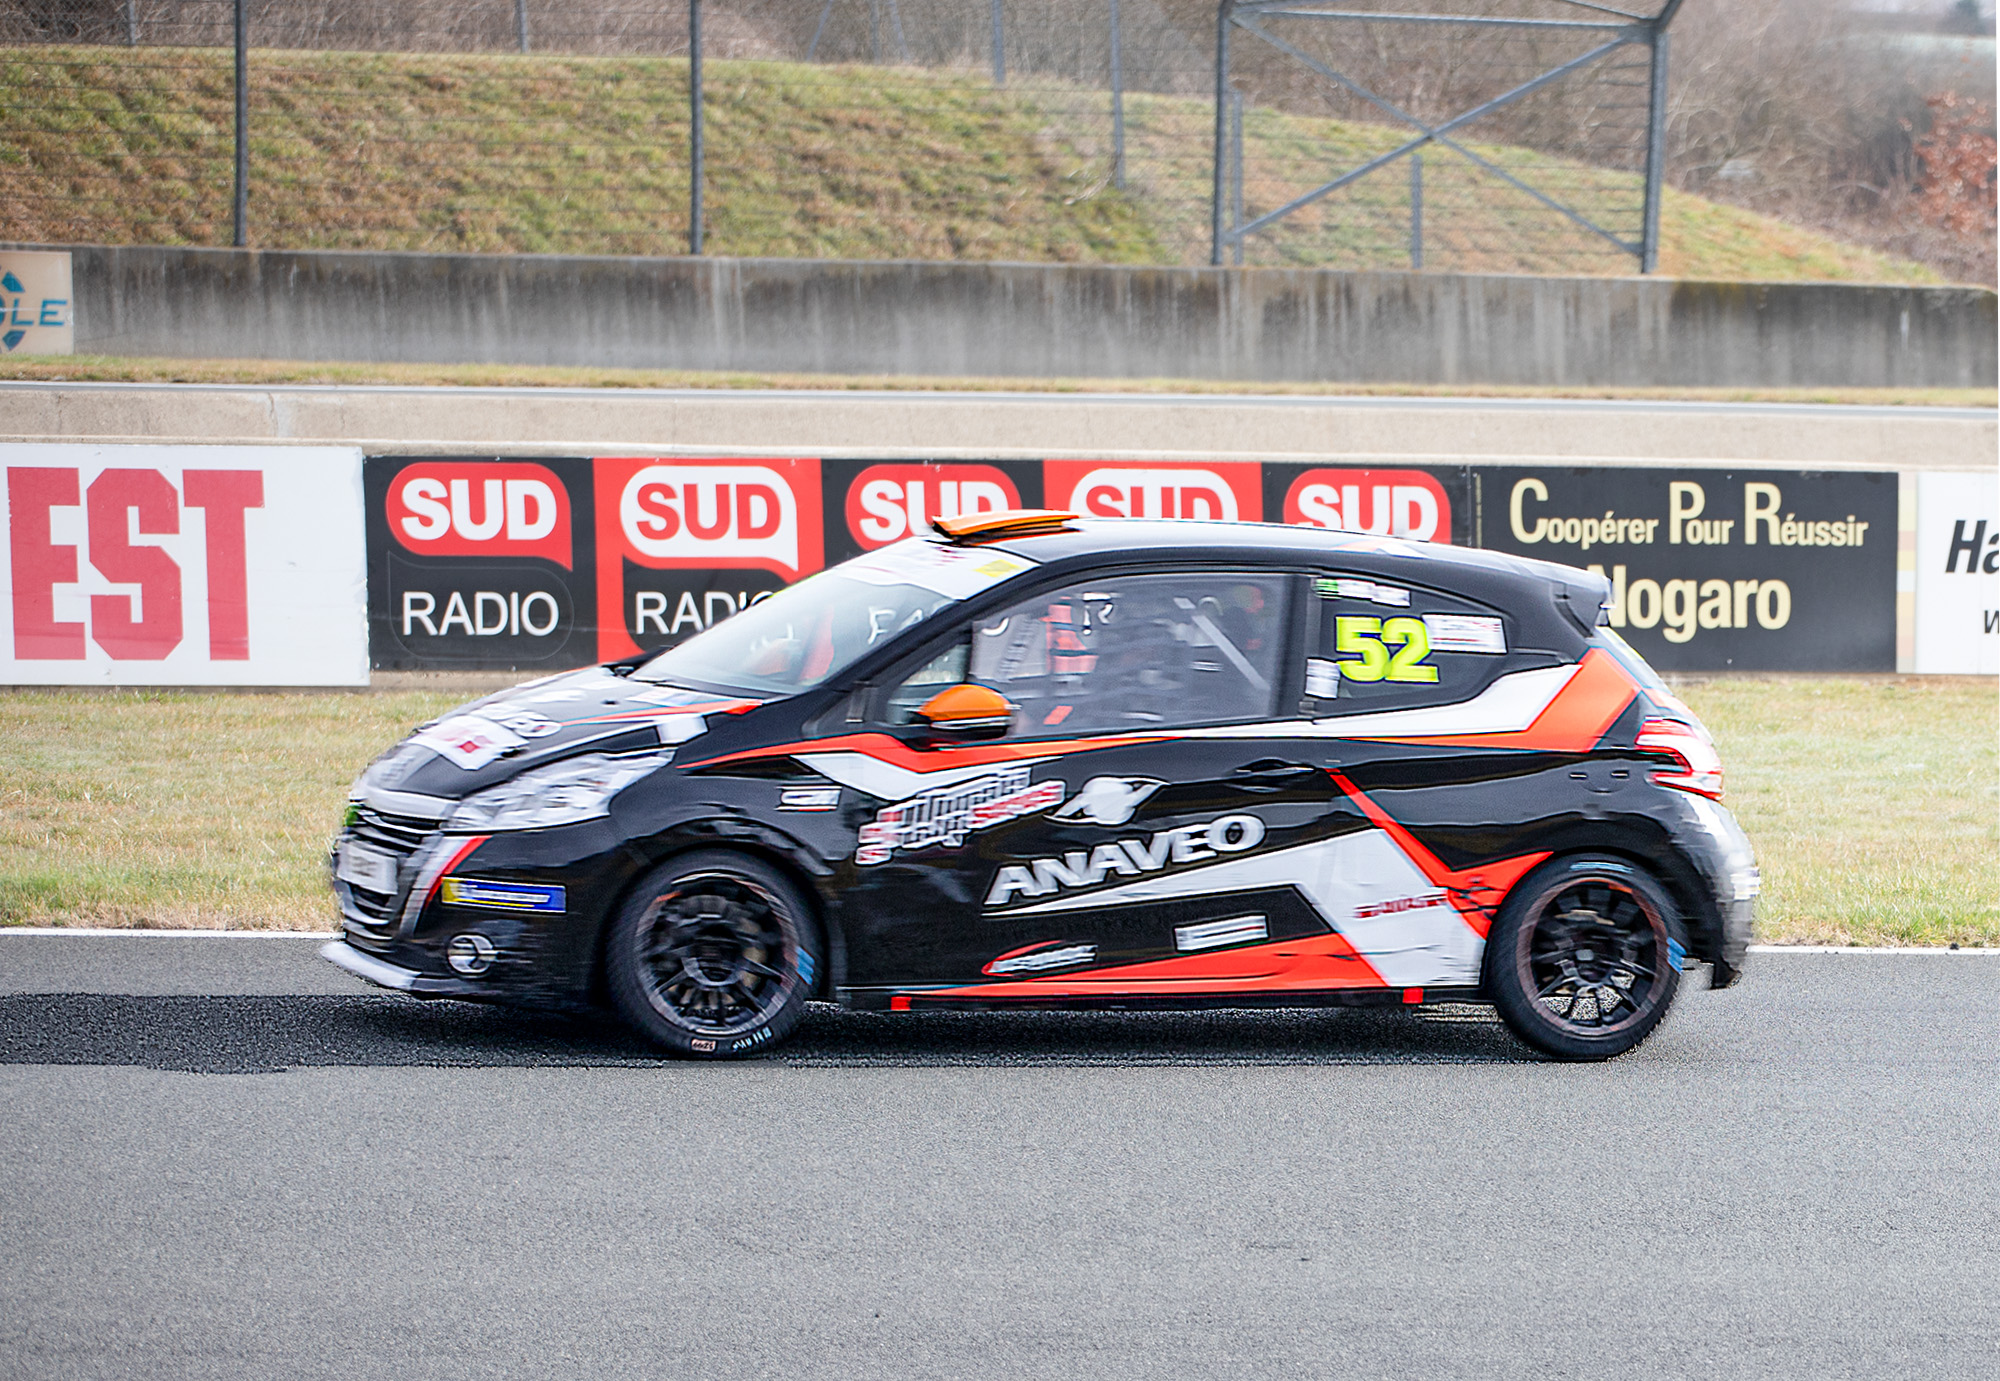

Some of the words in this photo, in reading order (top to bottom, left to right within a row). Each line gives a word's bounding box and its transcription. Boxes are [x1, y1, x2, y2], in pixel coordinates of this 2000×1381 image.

[401, 478, 557, 542] SUD
[635, 482, 782, 541] SUD
[1297, 484, 1439, 542] SUD
[1509, 477, 1660, 550] Coopérer
[1669, 481, 1735, 545] Pour
[1744, 482, 1870, 548] Réussir
[7, 467, 265, 661] EST
[402, 591, 559, 637] RADIO
[1335, 615, 1440, 684] 52
[983, 814, 1266, 905] ANAVEO
